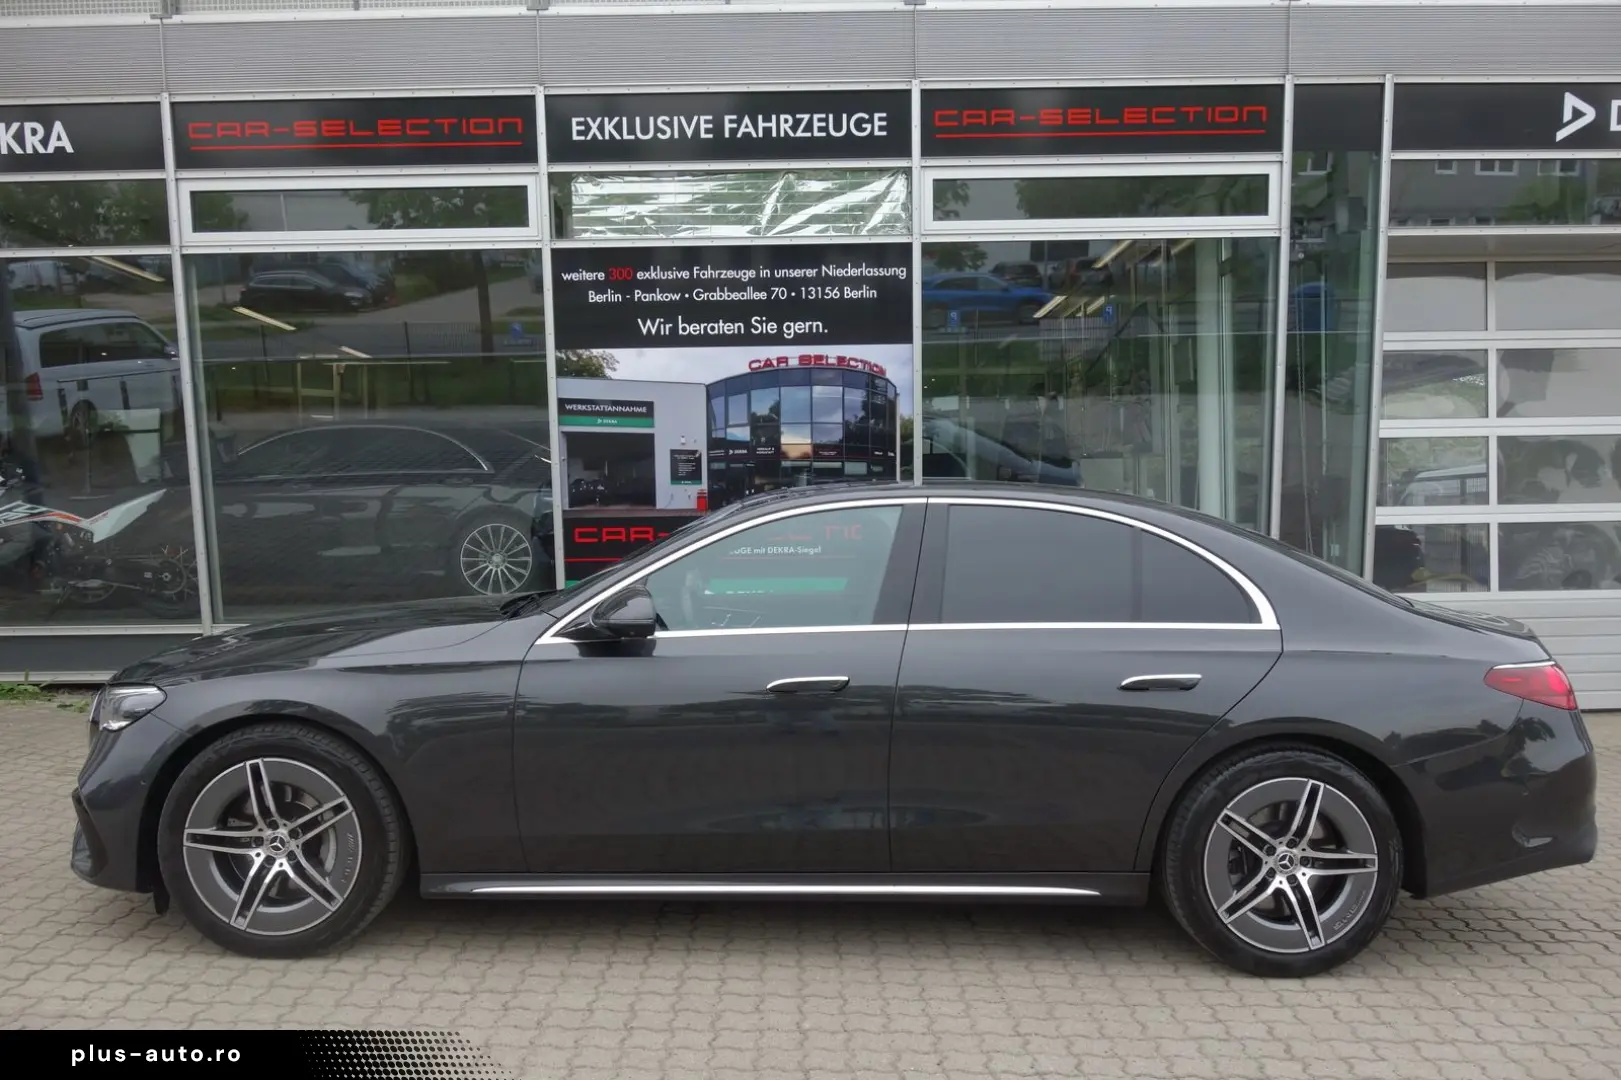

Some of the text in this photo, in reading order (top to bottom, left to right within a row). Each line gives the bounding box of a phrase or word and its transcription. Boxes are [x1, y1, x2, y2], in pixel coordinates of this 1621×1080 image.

[571, 112, 888, 141] EXKLUSIVE FAHRZEUGE
[933, 105, 1269, 128] CAR-SELECTION
[0, 119, 75, 155] KRA
[187, 116, 524, 140] CAR-SELECTION
[561, 263, 907, 283] weitere 300 exklusive Fahrzeuge in unserer Niederlassung
[588, 289, 622, 303] Berlin
[634, 288, 682, 302] Pankow
[692, 286, 768, 302] Grabbeallee
[770, 286, 788, 301] 70
[800, 286, 841, 300] 13156
[843, 284, 878, 299] Berlin
[637, 315, 829, 340] Wir beraten Sie gern.
[748, 355, 789, 372] CAR
[564, 403, 647, 413] WERKSTATTANNAHME
[753, 546, 766, 555] mit
[767, 545, 822, 556] DEKRA-Siegel
